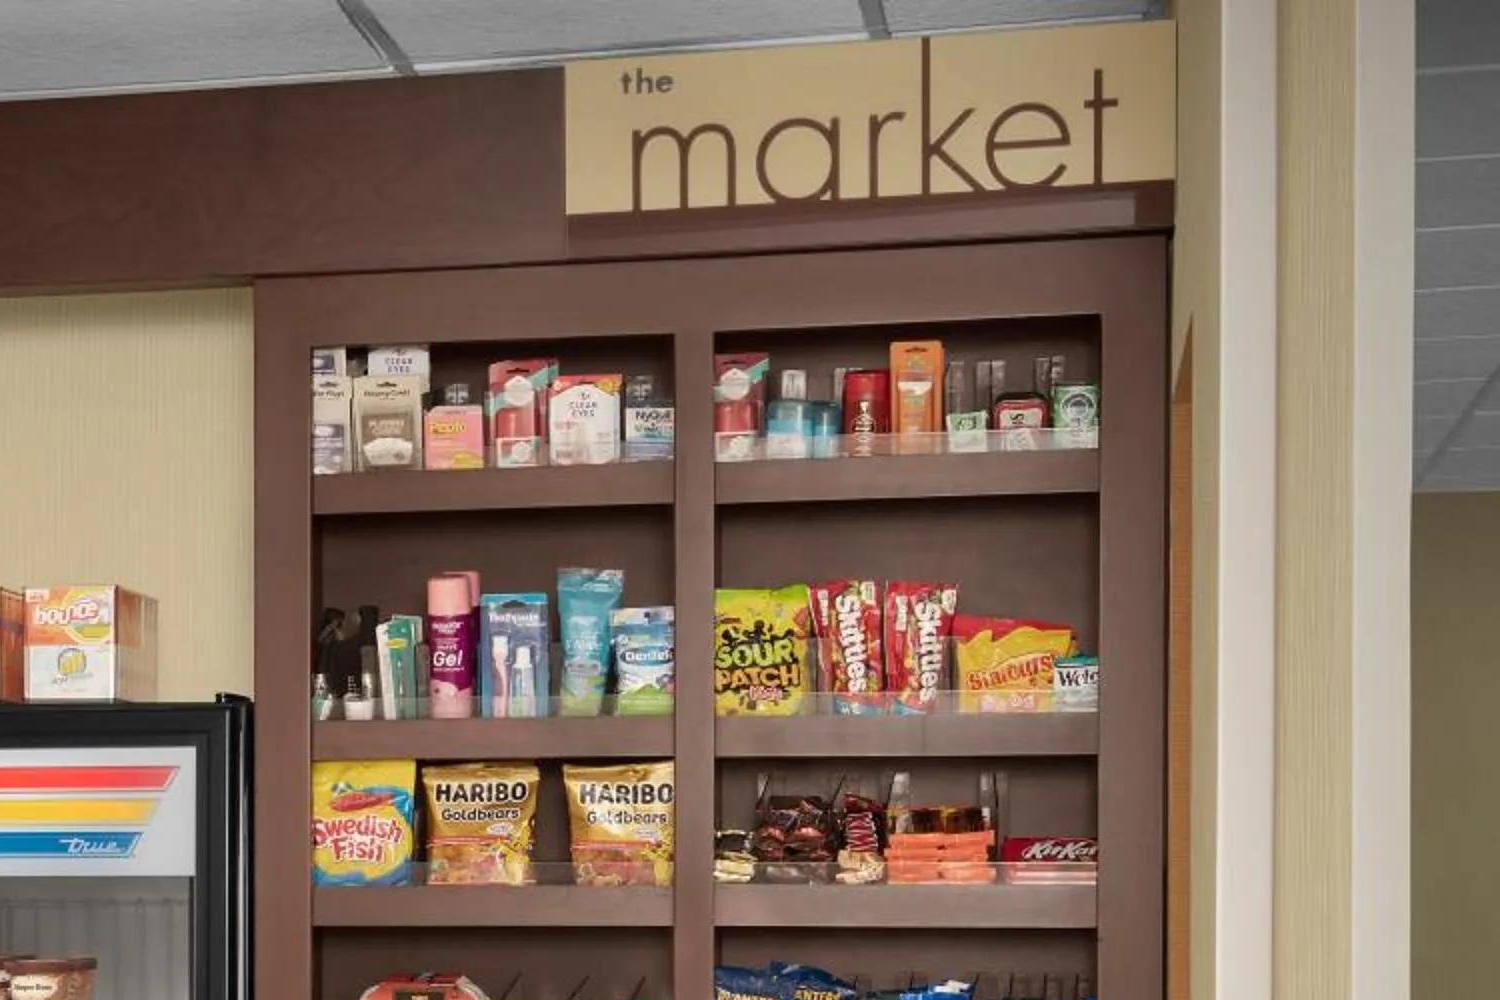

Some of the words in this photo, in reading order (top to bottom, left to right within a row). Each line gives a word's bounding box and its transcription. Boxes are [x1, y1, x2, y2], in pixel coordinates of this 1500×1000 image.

[621, 69, 674, 95] the
[632, 37, 1119, 212] market
[34, 602, 99, 625] bounce
[433, 649, 463, 667] Gel
[714, 640, 794, 669] SOUR
[835, 595, 867, 695] Skittles
[914, 601, 943, 702] Skittles
[714, 664, 801, 693] PATCH
[435, 781, 527, 804] HARIBO
[579, 783, 673, 806] HARIBO
[311, 817, 404, 855] Swedish
[441, 817, 520, 832] Goldbears
[586, 820, 667, 835] Goldbears
[331, 841, 386, 873] Fish
